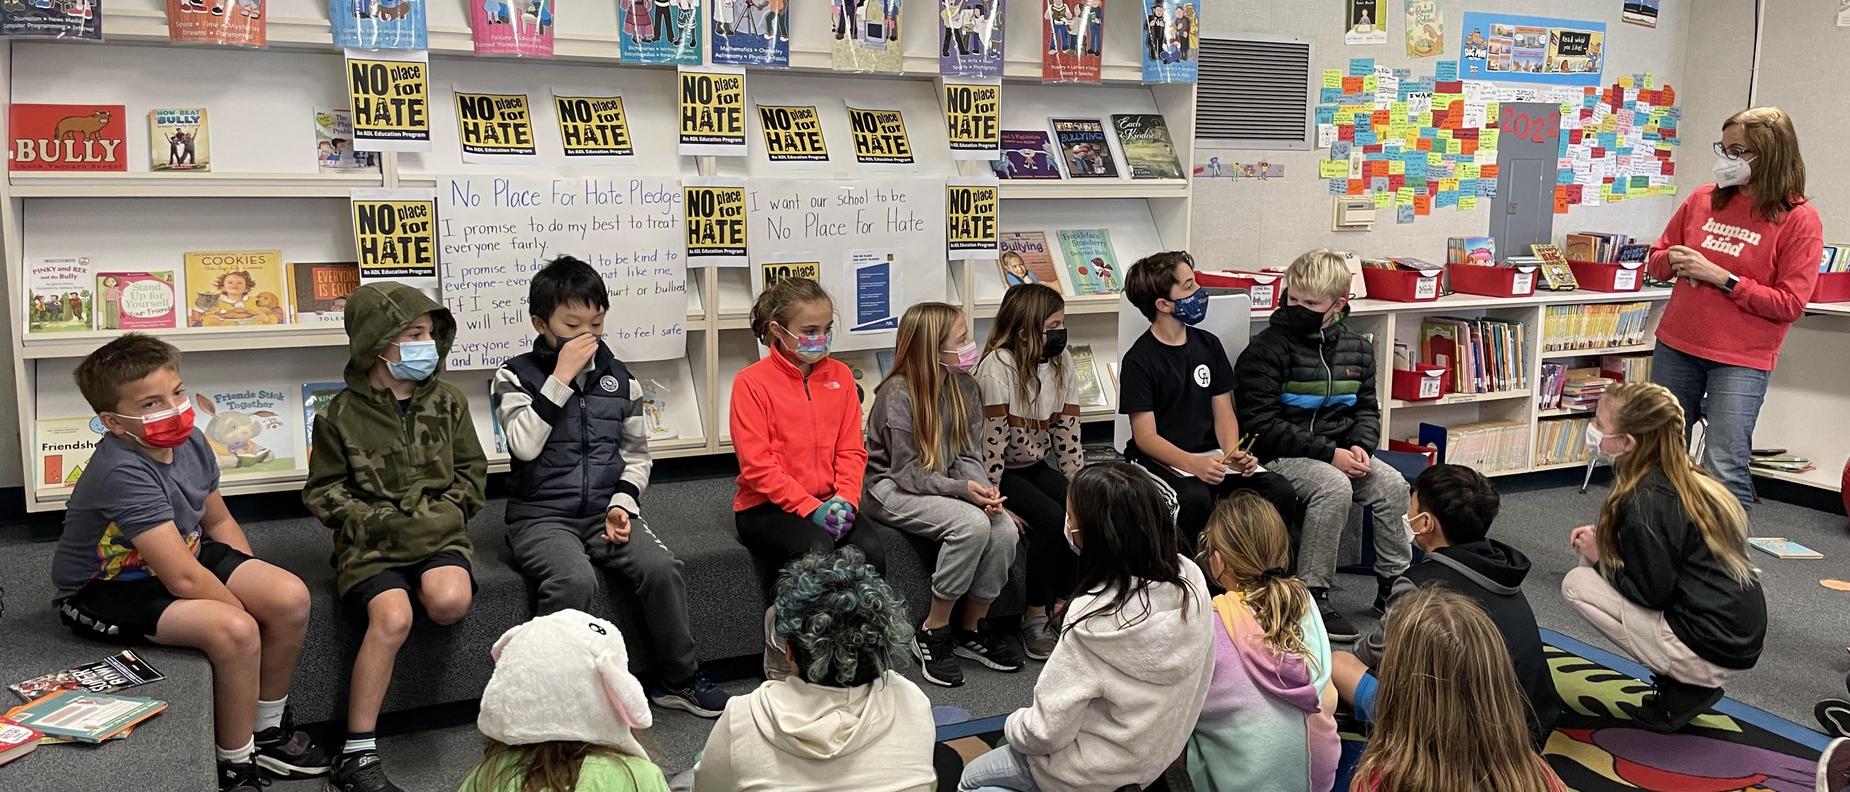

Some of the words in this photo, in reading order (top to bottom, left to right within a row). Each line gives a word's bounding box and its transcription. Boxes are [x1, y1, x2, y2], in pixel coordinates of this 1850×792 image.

[352, 63, 389, 95] NO
[390, 65, 421, 83] place
[394, 83, 422, 96] for
[683, 76, 712, 104] NO
[714, 78, 738, 93] place
[460, 96, 494, 120] NO
[497, 97, 522, 111] place
[717, 93, 740, 105] for
[947, 87, 971, 114] NO
[973, 88, 995, 102] place
[975, 102, 996, 114] for
[157, 115, 200, 124] BULLY
[354, 97, 425, 127] HATE
[500, 111, 525, 121] for
[558, 99, 592, 123] NO
[592, 100, 618, 113] place
[596, 113, 620, 123] for
[683, 106, 741, 132] HATE
[761, 108, 791, 130] NO
[791, 109, 812, 120] place
[850, 111, 878, 133] NO
[878, 113, 898, 124] place
[1118, 116, 1142, 128] Each
[463, 121, 530, 144] HATE
[795, 121, 816, 130] for
[882, 124, 901, 134] for
[949, 115, 996, 139] HATE
[1501, 104, 1559, 143] 2022
[563, 124, 627, 146] HATE
[766, 131, 823, 152] HATE
[855, 134, 908, 154] HATE
[1060, 132, 1103, 142] BULLYING
[15, 139, 121, 162] BULLY
[452, 179, 480, 207] No
[494, 179, 541, 208] Place
[552, 179, 577, 206] For
[585, 178, 623, 205] Hate
[630, 179, 681, 215] Pledge
[688, 190, 714, 218] NO
[717, 191, 741, 206] place
[750, 192, 761, 212] I
[770, 193, 801, 210] want
[810, 196, 829, 208] our
[837, 188, 869, 206] school
[874, 188, 887, 202] to
[891, 188, 907, 203] be
[950, 189, 971, 214] NO
[973, 189, 993, 203] place
[358, 204, 395, 235] NO
[397, 205, 426, 221] place
[719, 206, 743, 218] for
[974, 203, 994, 214] for
[400, 221, 428, 234] for
[441, 219, 456, 237] I
[464, 224, 517, 242] promise
[528, 216, 544, 232] to
[549, 218, 563, 232] do
[568, 223, 587, 240] my
[593, 214, 622, 231] best
[628, 214, 642, 229] to
[646, 214, 679, 229] treat
[688, 219, 743, 244] HATE
[767, 216, 791, 240] No
[805, 212, 847, 239] Place
[856, 208, 875, 234] For
[886, 207, 924, 233] Hate
[950, 216, 994, 239] HATE
[1702, 217, 1761, 246] human
[361, 237, 431, 264] HATE
[445, 241, 501, 258] everyone
[510, 237, 549, 258] fairly.
[1000, 241, 1044, 253] Bullying
[33, 266, 56, 274] PINKY
[201, 256, 265, 265] COOKIES
[442, 263, 454, 278] I
[461, 265, 506, 284] promise
[514, 258, 526, 273] to
[530, 258, 543, 272] do
[598, 254, 611, 267] to
[615, 252, 629, 265] be
[634, 249, 658, 263] kind
[664, 249, 678, 260] to
[602, 268, 618, 279] not
[627, 266, 647, 277] like
[654, 267, 673, 276] me.
[131, 292, 146, 300] Up
[150, 292, 163, 300] for
[133, 283, 160, 291] Stand
[319, 283, 328, 297] IS
[470, 296, 483, 312] I
[492, 299, 511, 309] see
[607, 284, 629, 297] hurt
[637, 287, 649, 296] or
[655, 280, 687, 294] bullied,
[125, 299, 169, 308] Yourself
[466, 313, 491, 331] will
[501, 310, 523, 325] tell
[450, 338, 510, 356] Everyone
[617, 329, 630, 339] to
[634, 325, 655, 339] feel
[661, 324, 682, 336] safe
[452, 354, 471, 366] and
[214, 391, 256, 403] Friends
[258, 390, 285, 401] Stick
[226, 400, 275, 410] Together
[72, 668, 111, 692] SUPER
[91, 664, 127, 686] BOWL
